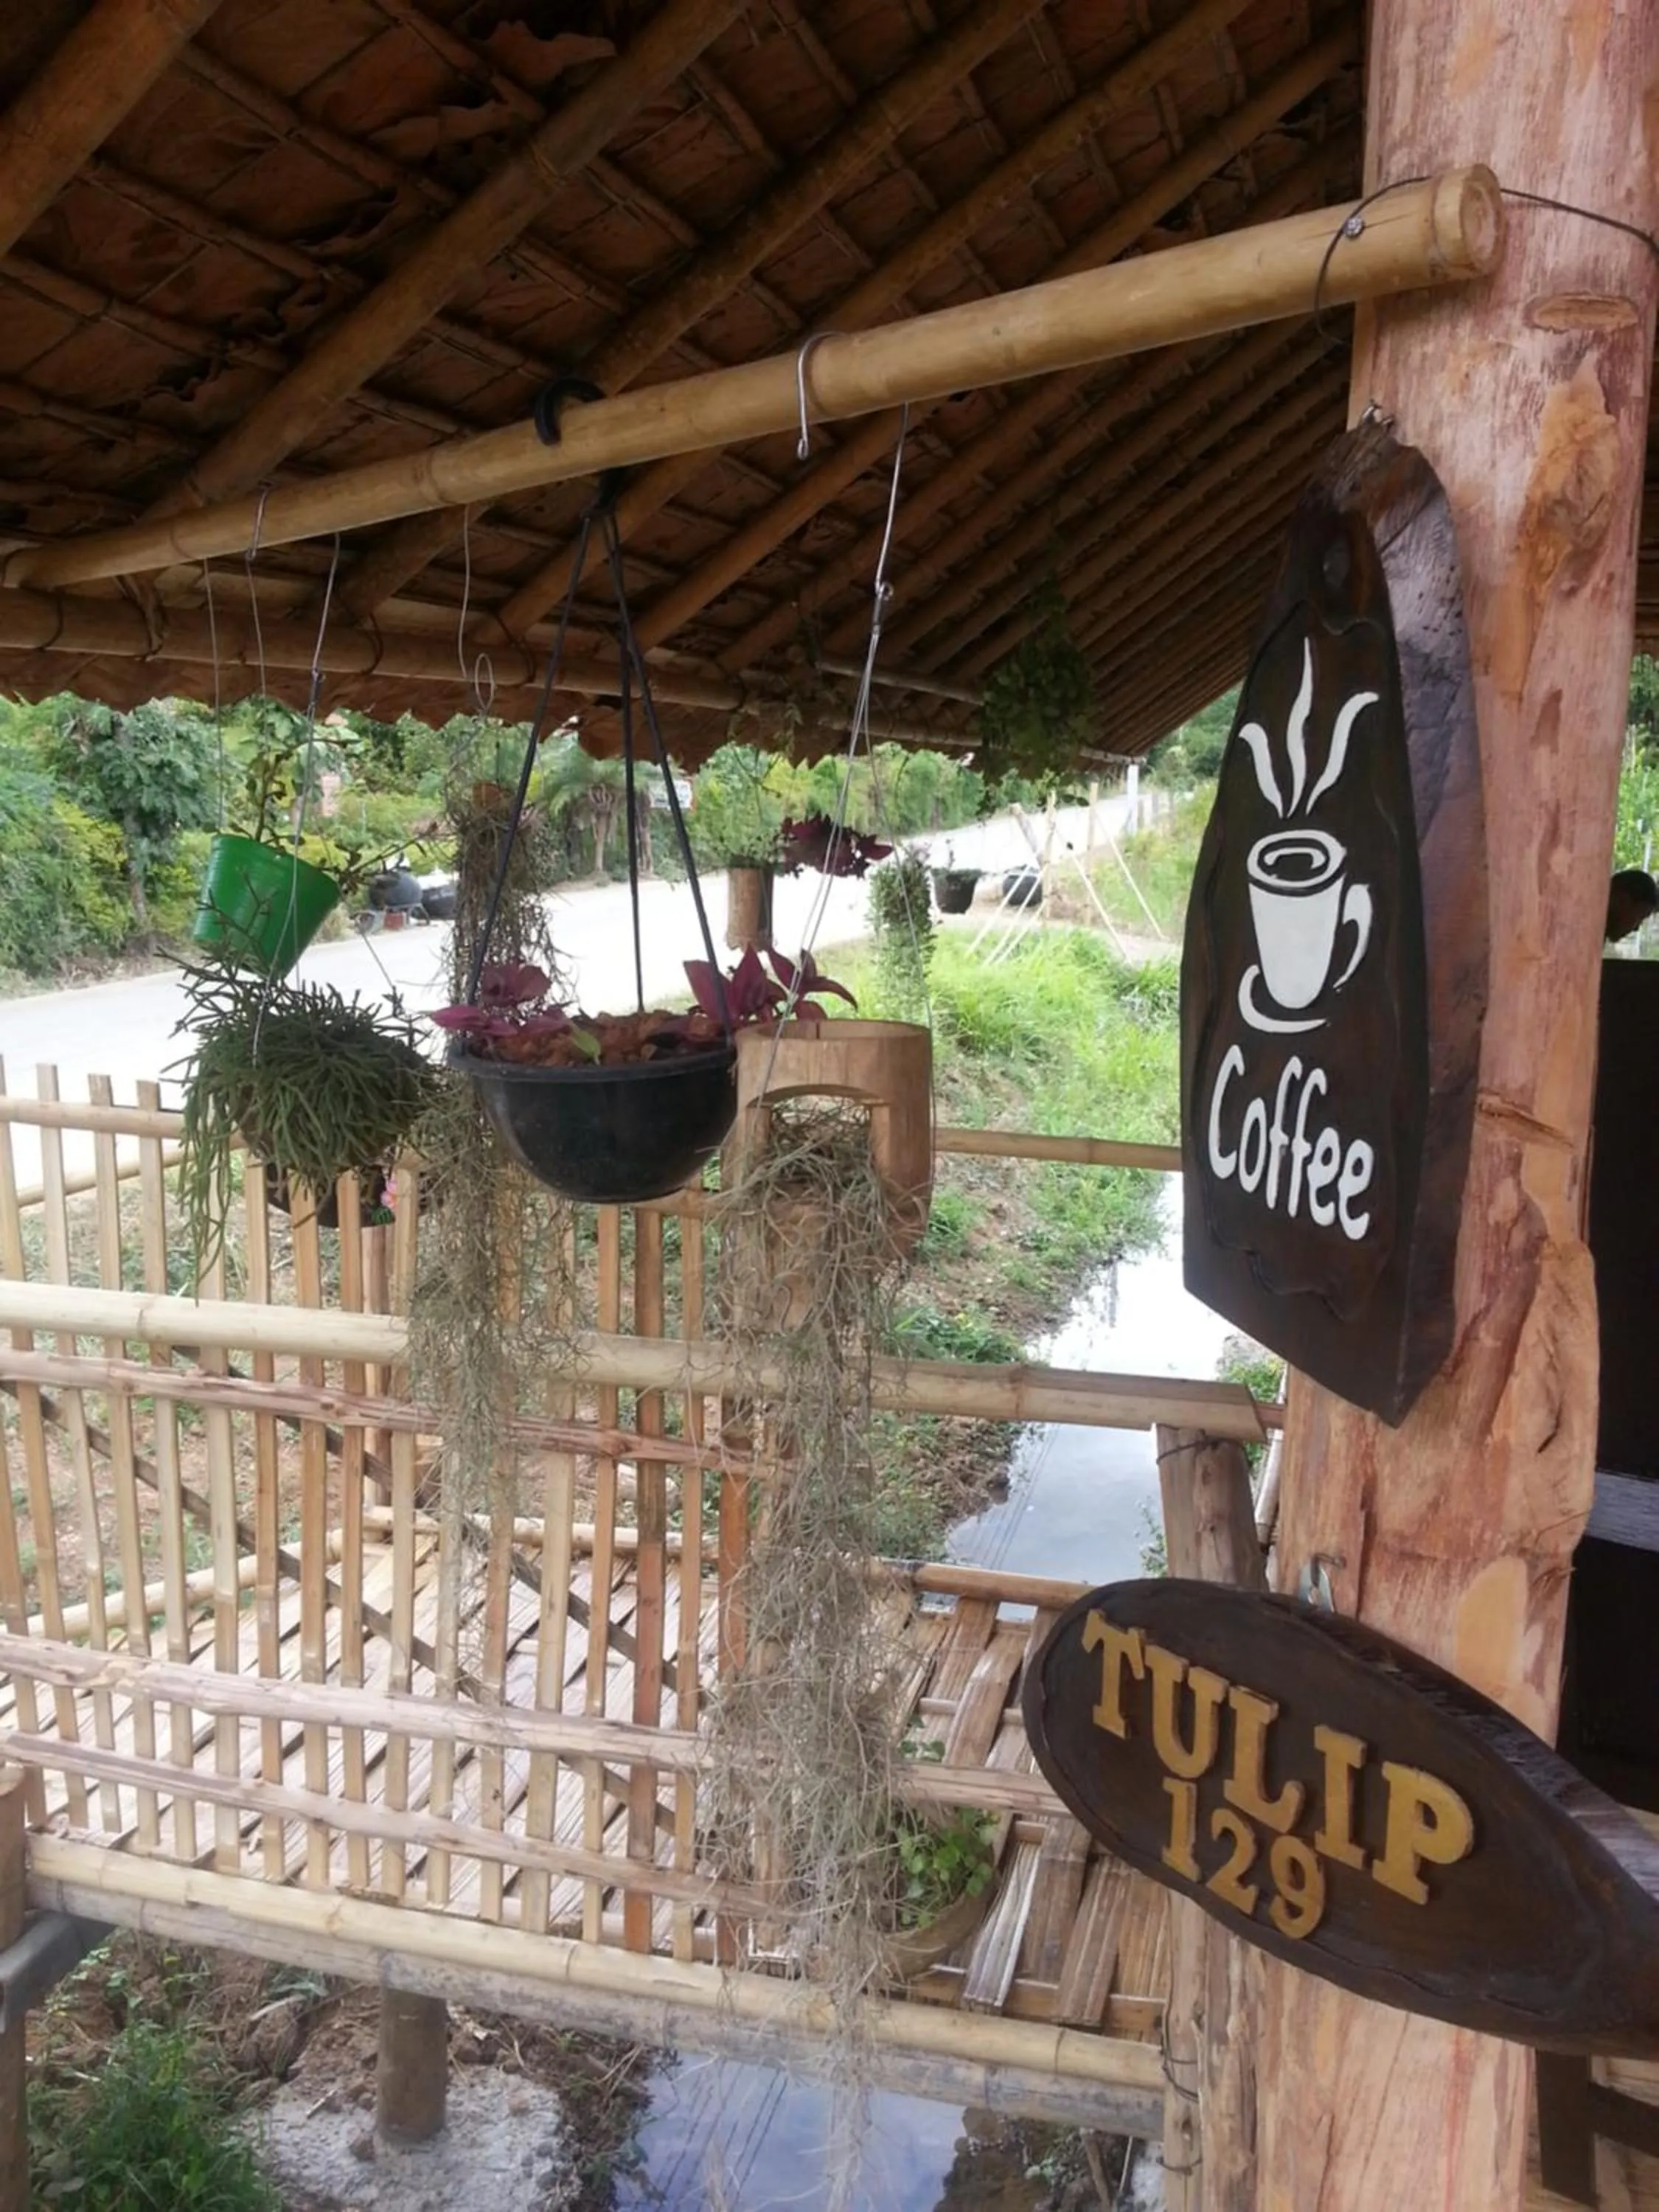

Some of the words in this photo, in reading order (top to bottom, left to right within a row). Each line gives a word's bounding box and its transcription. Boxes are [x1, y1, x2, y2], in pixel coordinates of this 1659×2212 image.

[1208, 1043, 1374, 1241] Coffee
[1081, 1608, 1473, 1905] TULIP
[1162, 1777, 1324, 1939] 129
